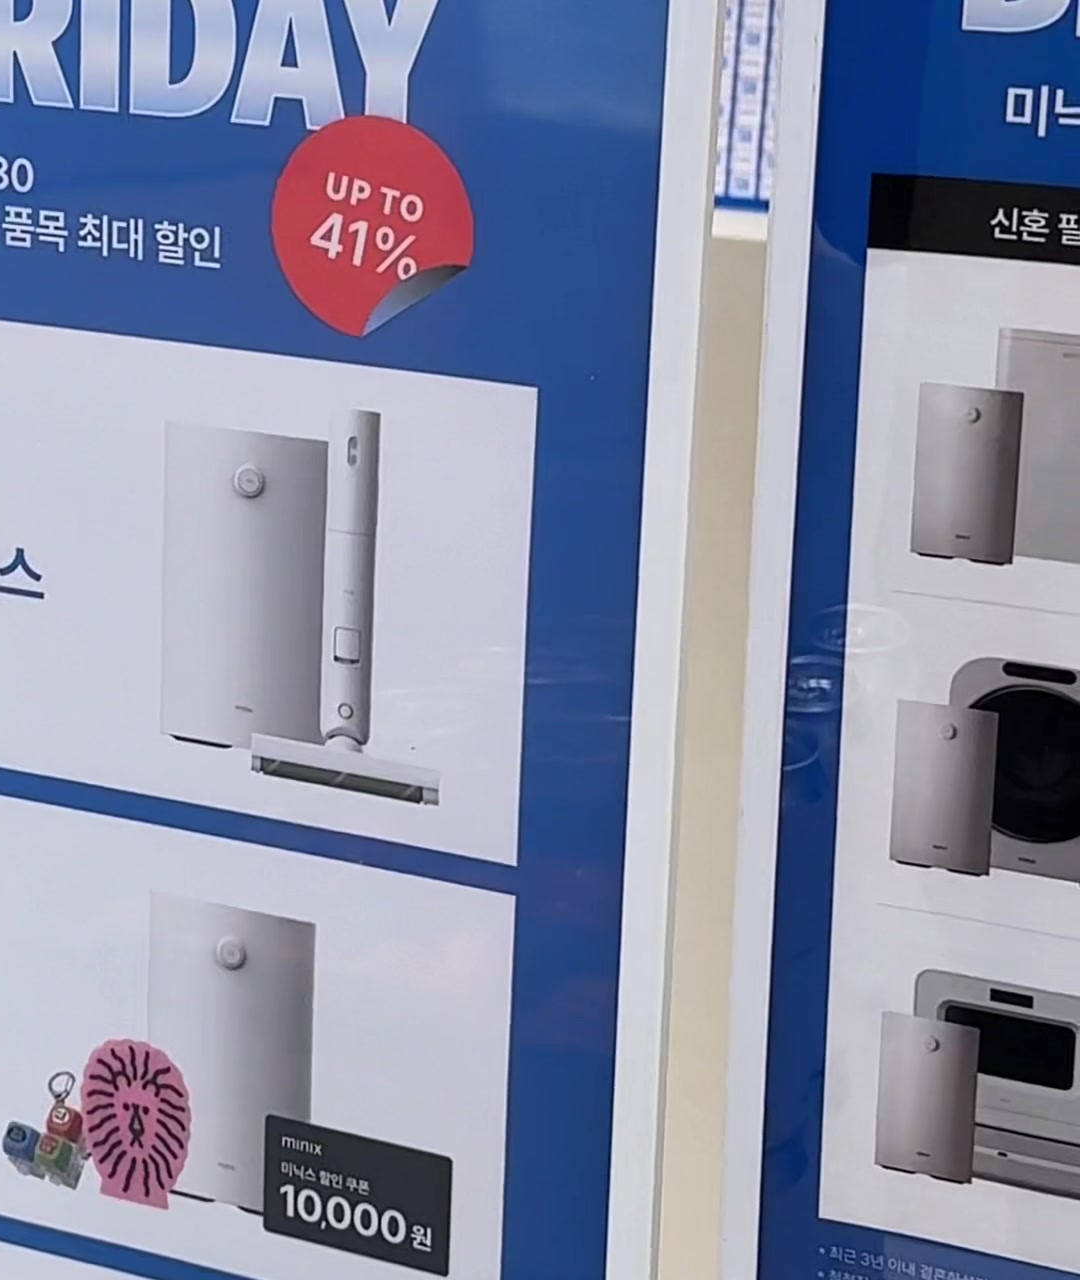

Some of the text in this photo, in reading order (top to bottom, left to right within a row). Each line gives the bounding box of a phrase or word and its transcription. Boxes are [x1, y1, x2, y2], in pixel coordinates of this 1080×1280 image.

[325, 171, 425, 223] UP TO
[2, 205, 69, 252] 품목
[78, 213, 145, 261] 최대
[153, 220, 223, 269] 할인
[990, 207, 1050, 243] 신혼
[310, 213, 418, 282] 41%
[281, 1136, 323, 1156] minix
[280, 1161, 371, 1196] 미닉스 할인 쿠폰
